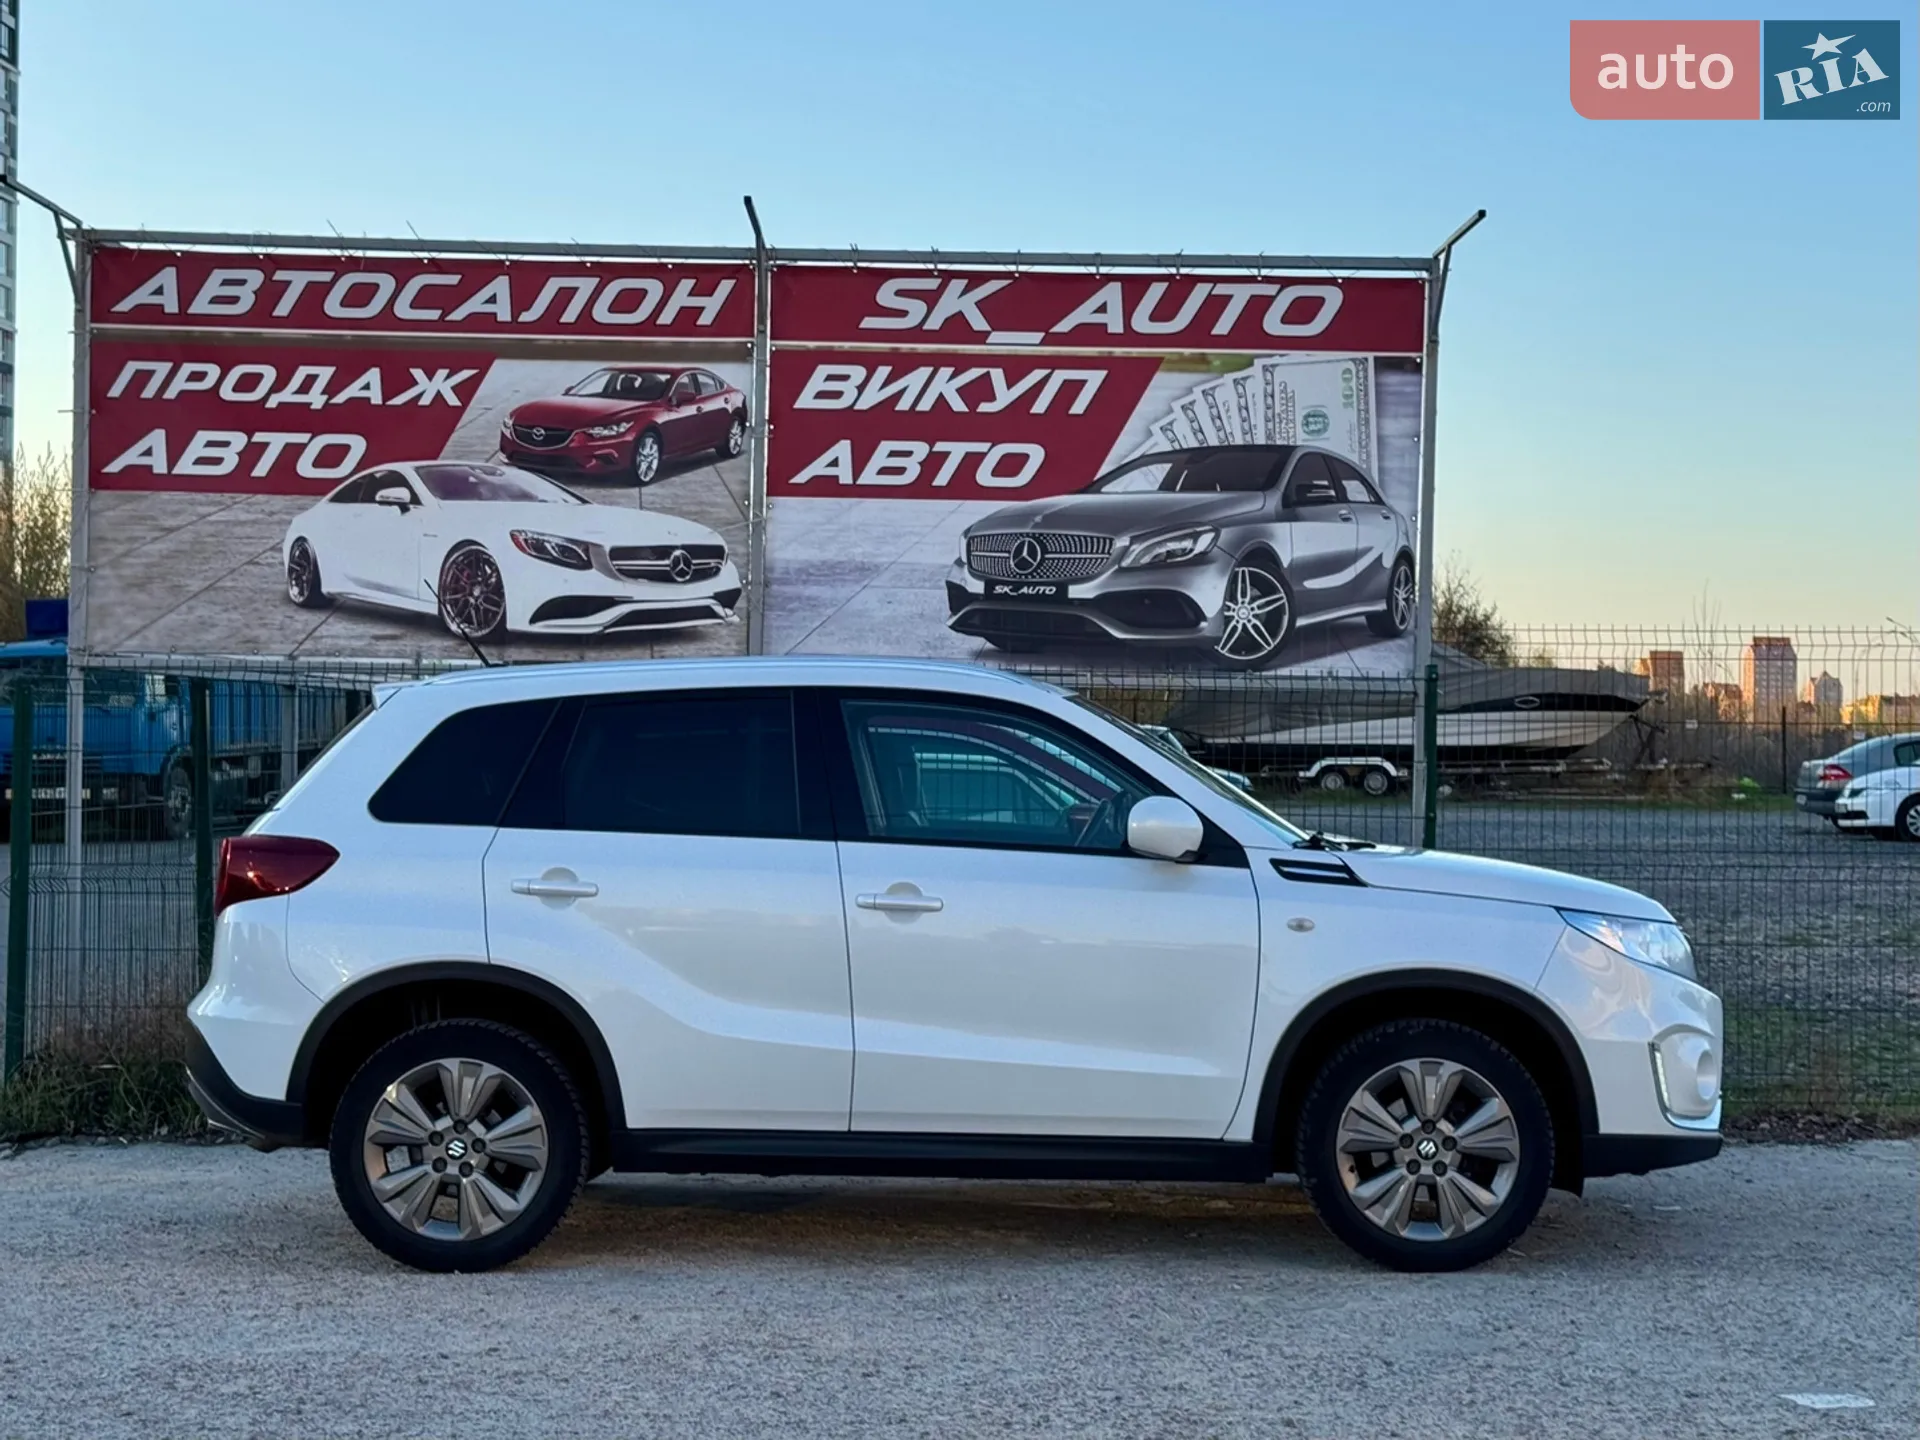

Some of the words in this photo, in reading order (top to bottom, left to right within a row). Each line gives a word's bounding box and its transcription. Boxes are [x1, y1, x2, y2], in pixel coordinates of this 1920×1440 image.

[110, 265, 737, 326] АВТОСАЛОН
[857, 277, 1345, 346] SK_AUTO
[106, 359, 480, 410] ПРОДАЖ
[791, 363, 1110, 416] ВИКУП
[101, 427, 368, 480] АВТО
[787, 438, 1047, 489] АВТО
[993, 584, 1057, 596] SK_AUTO
